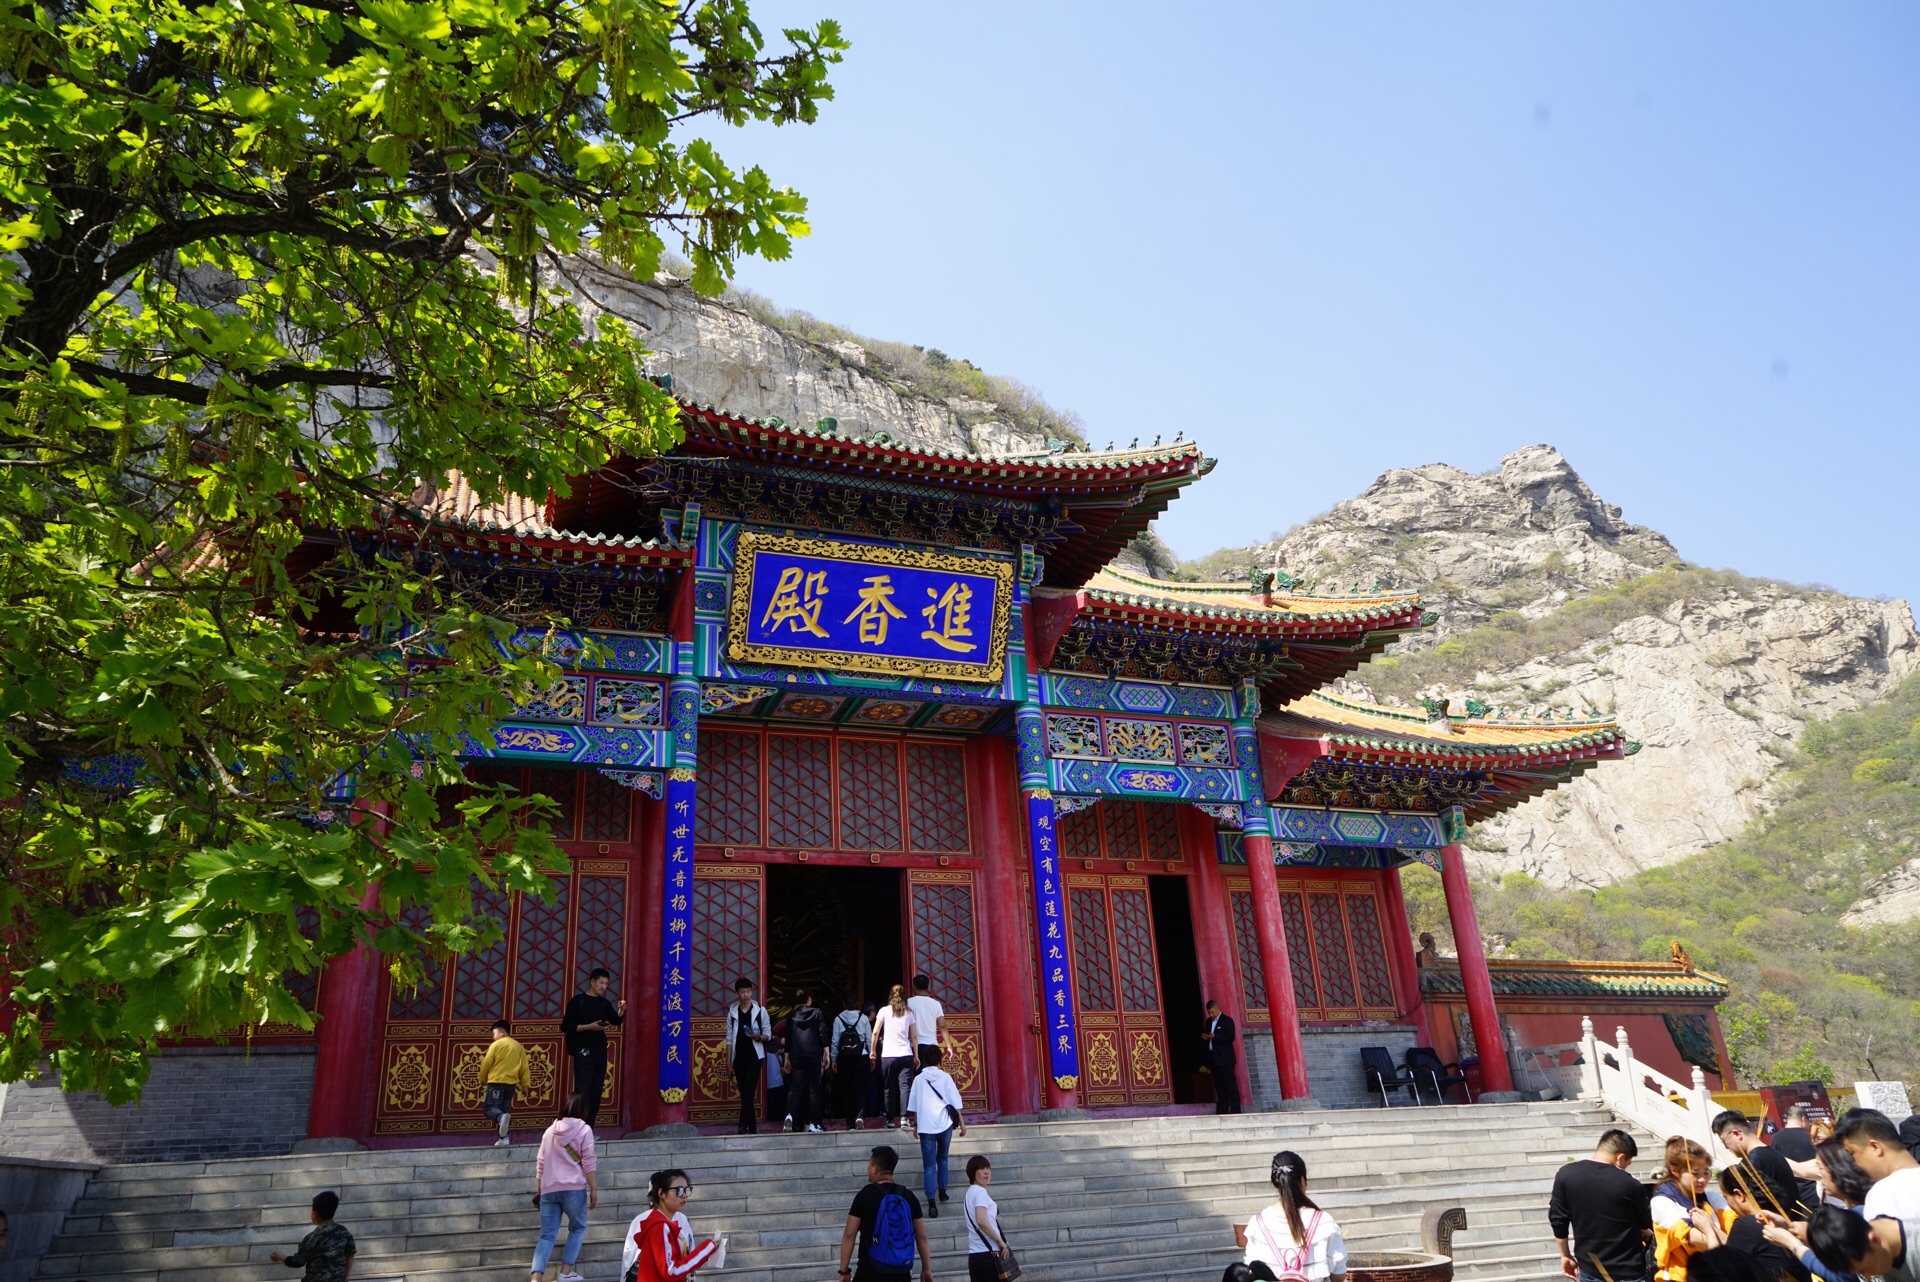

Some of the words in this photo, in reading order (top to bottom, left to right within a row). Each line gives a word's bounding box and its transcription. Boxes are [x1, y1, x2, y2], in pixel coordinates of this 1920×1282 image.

[1037, 815, 1072, 1055] 观空有色莲花九品香三界
